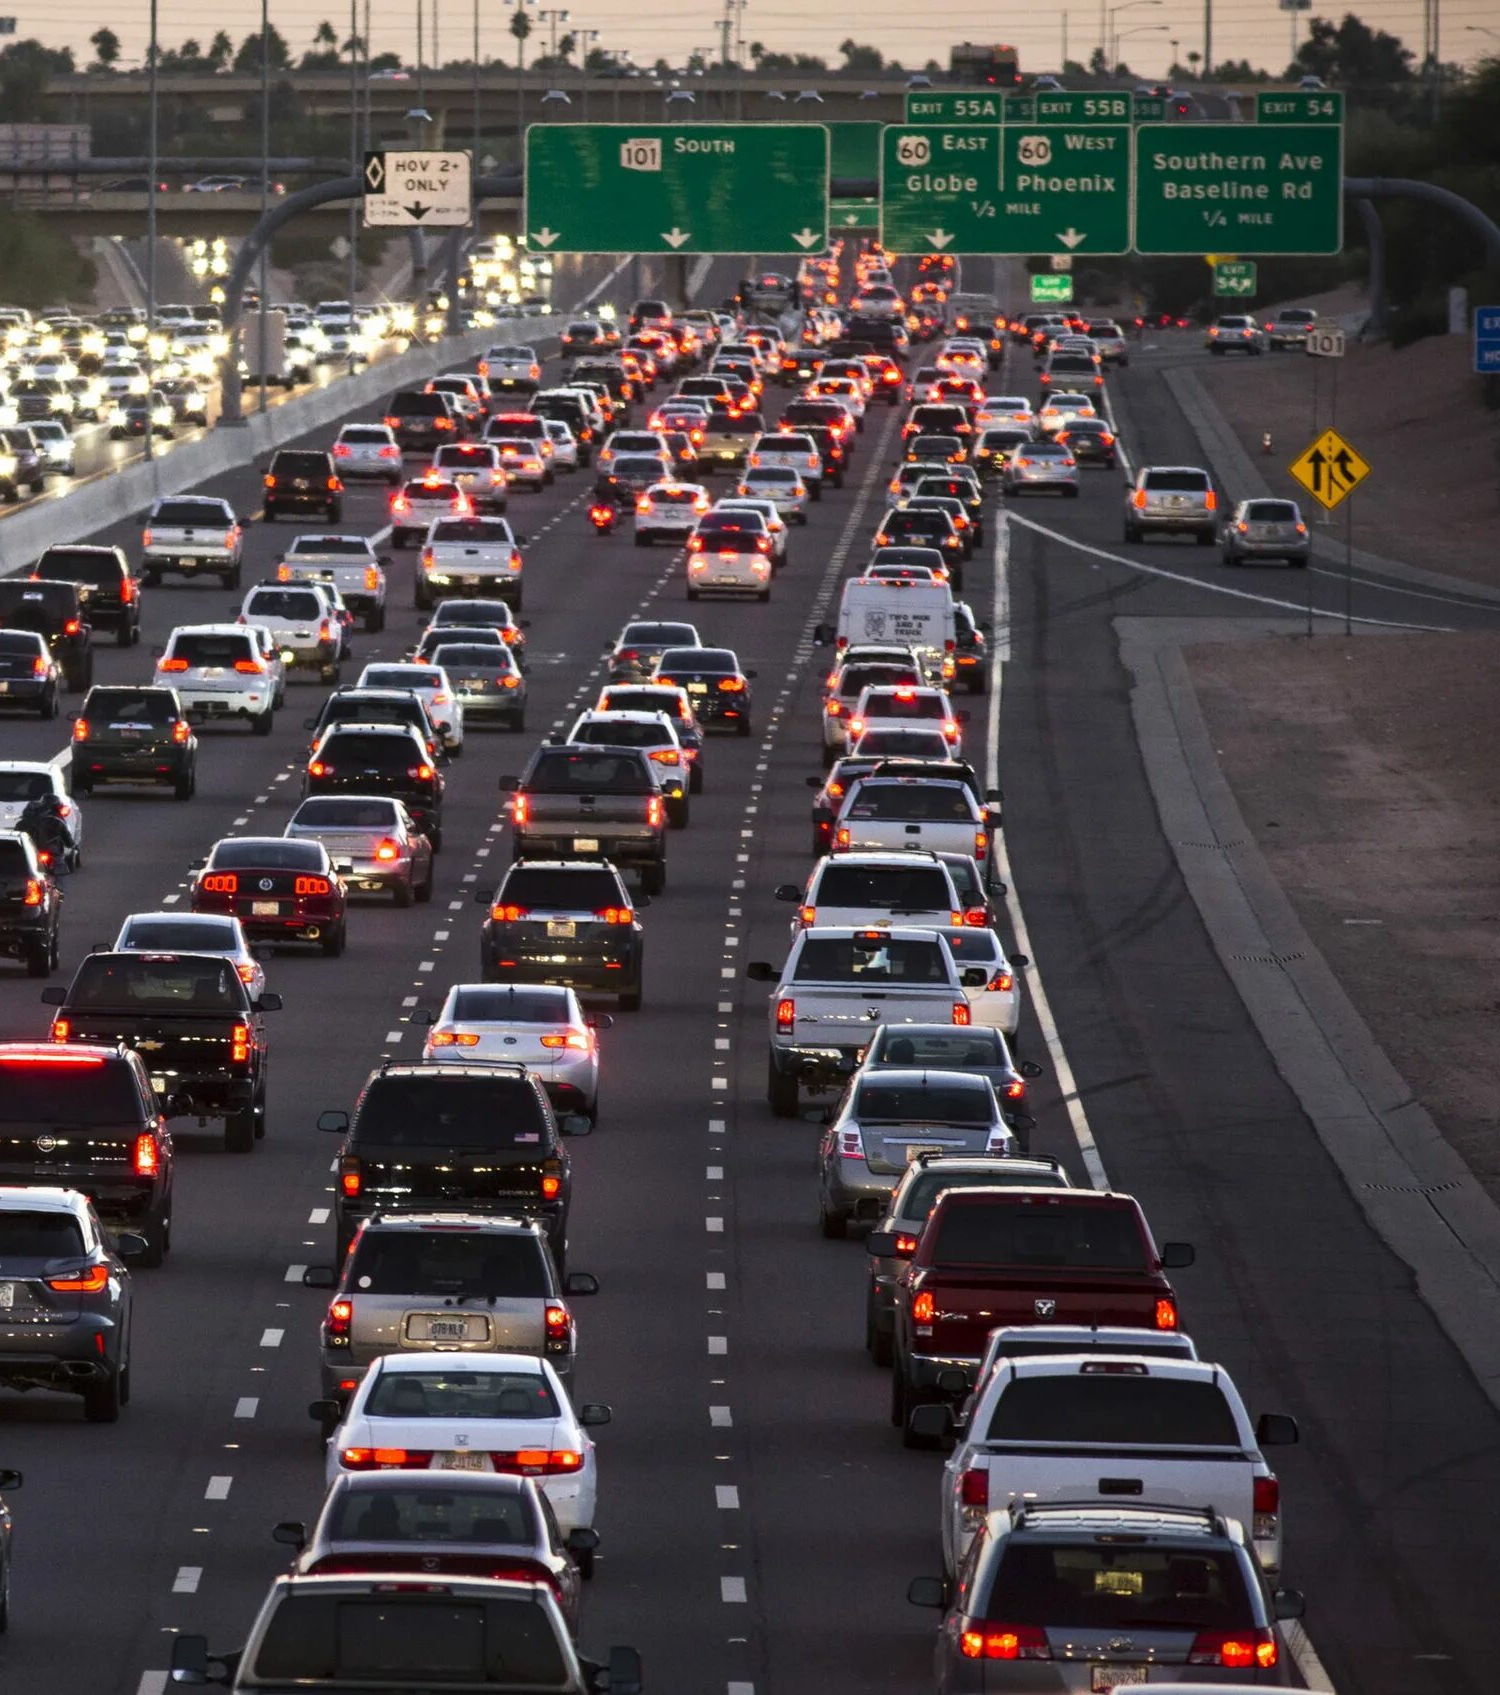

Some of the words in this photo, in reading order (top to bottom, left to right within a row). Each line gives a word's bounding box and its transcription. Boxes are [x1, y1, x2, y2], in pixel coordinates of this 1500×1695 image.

[911, 102, 943, 115] EXIT
[955, 100, 997, 116] 55A
[1040, 102, 1073, 115] EXIT
[1084, 100, 1126, 116] 55B
[1263, 102, 1296, 114] EXIT
[1307, 100, 1335, 116] 54
[673, 136, 736, 153] SOUTH
[942, 134, 988, 150] EAST
[1064, 134, 1117, 150] WEST
[626, 147, 657, 166] 101
[901, 142, 929, 160] 60
[1021, 142, 1049, 160] 60
[395, 160, 429, 172] HOV
[439, 160, 459, 172] 2+
[1153, 152, 1267, 171] Southern
[1279, 153, 1323, 171] Ave
[405, 179, 449, 192] ONLY
[907, 174, 978, 192] Globe
[1016, 173, 1116, 192] Phoenix
[1163, 180, 1270, 199] Baseline
[1282, 181, 1313, 199] Rd
[1006, 204, 1041, 215] MILE
[1238, 213, 1274, 224] MILE
[1311, 335, 1344, 352] 101
[894, 628, 922, 636] TRUCK
